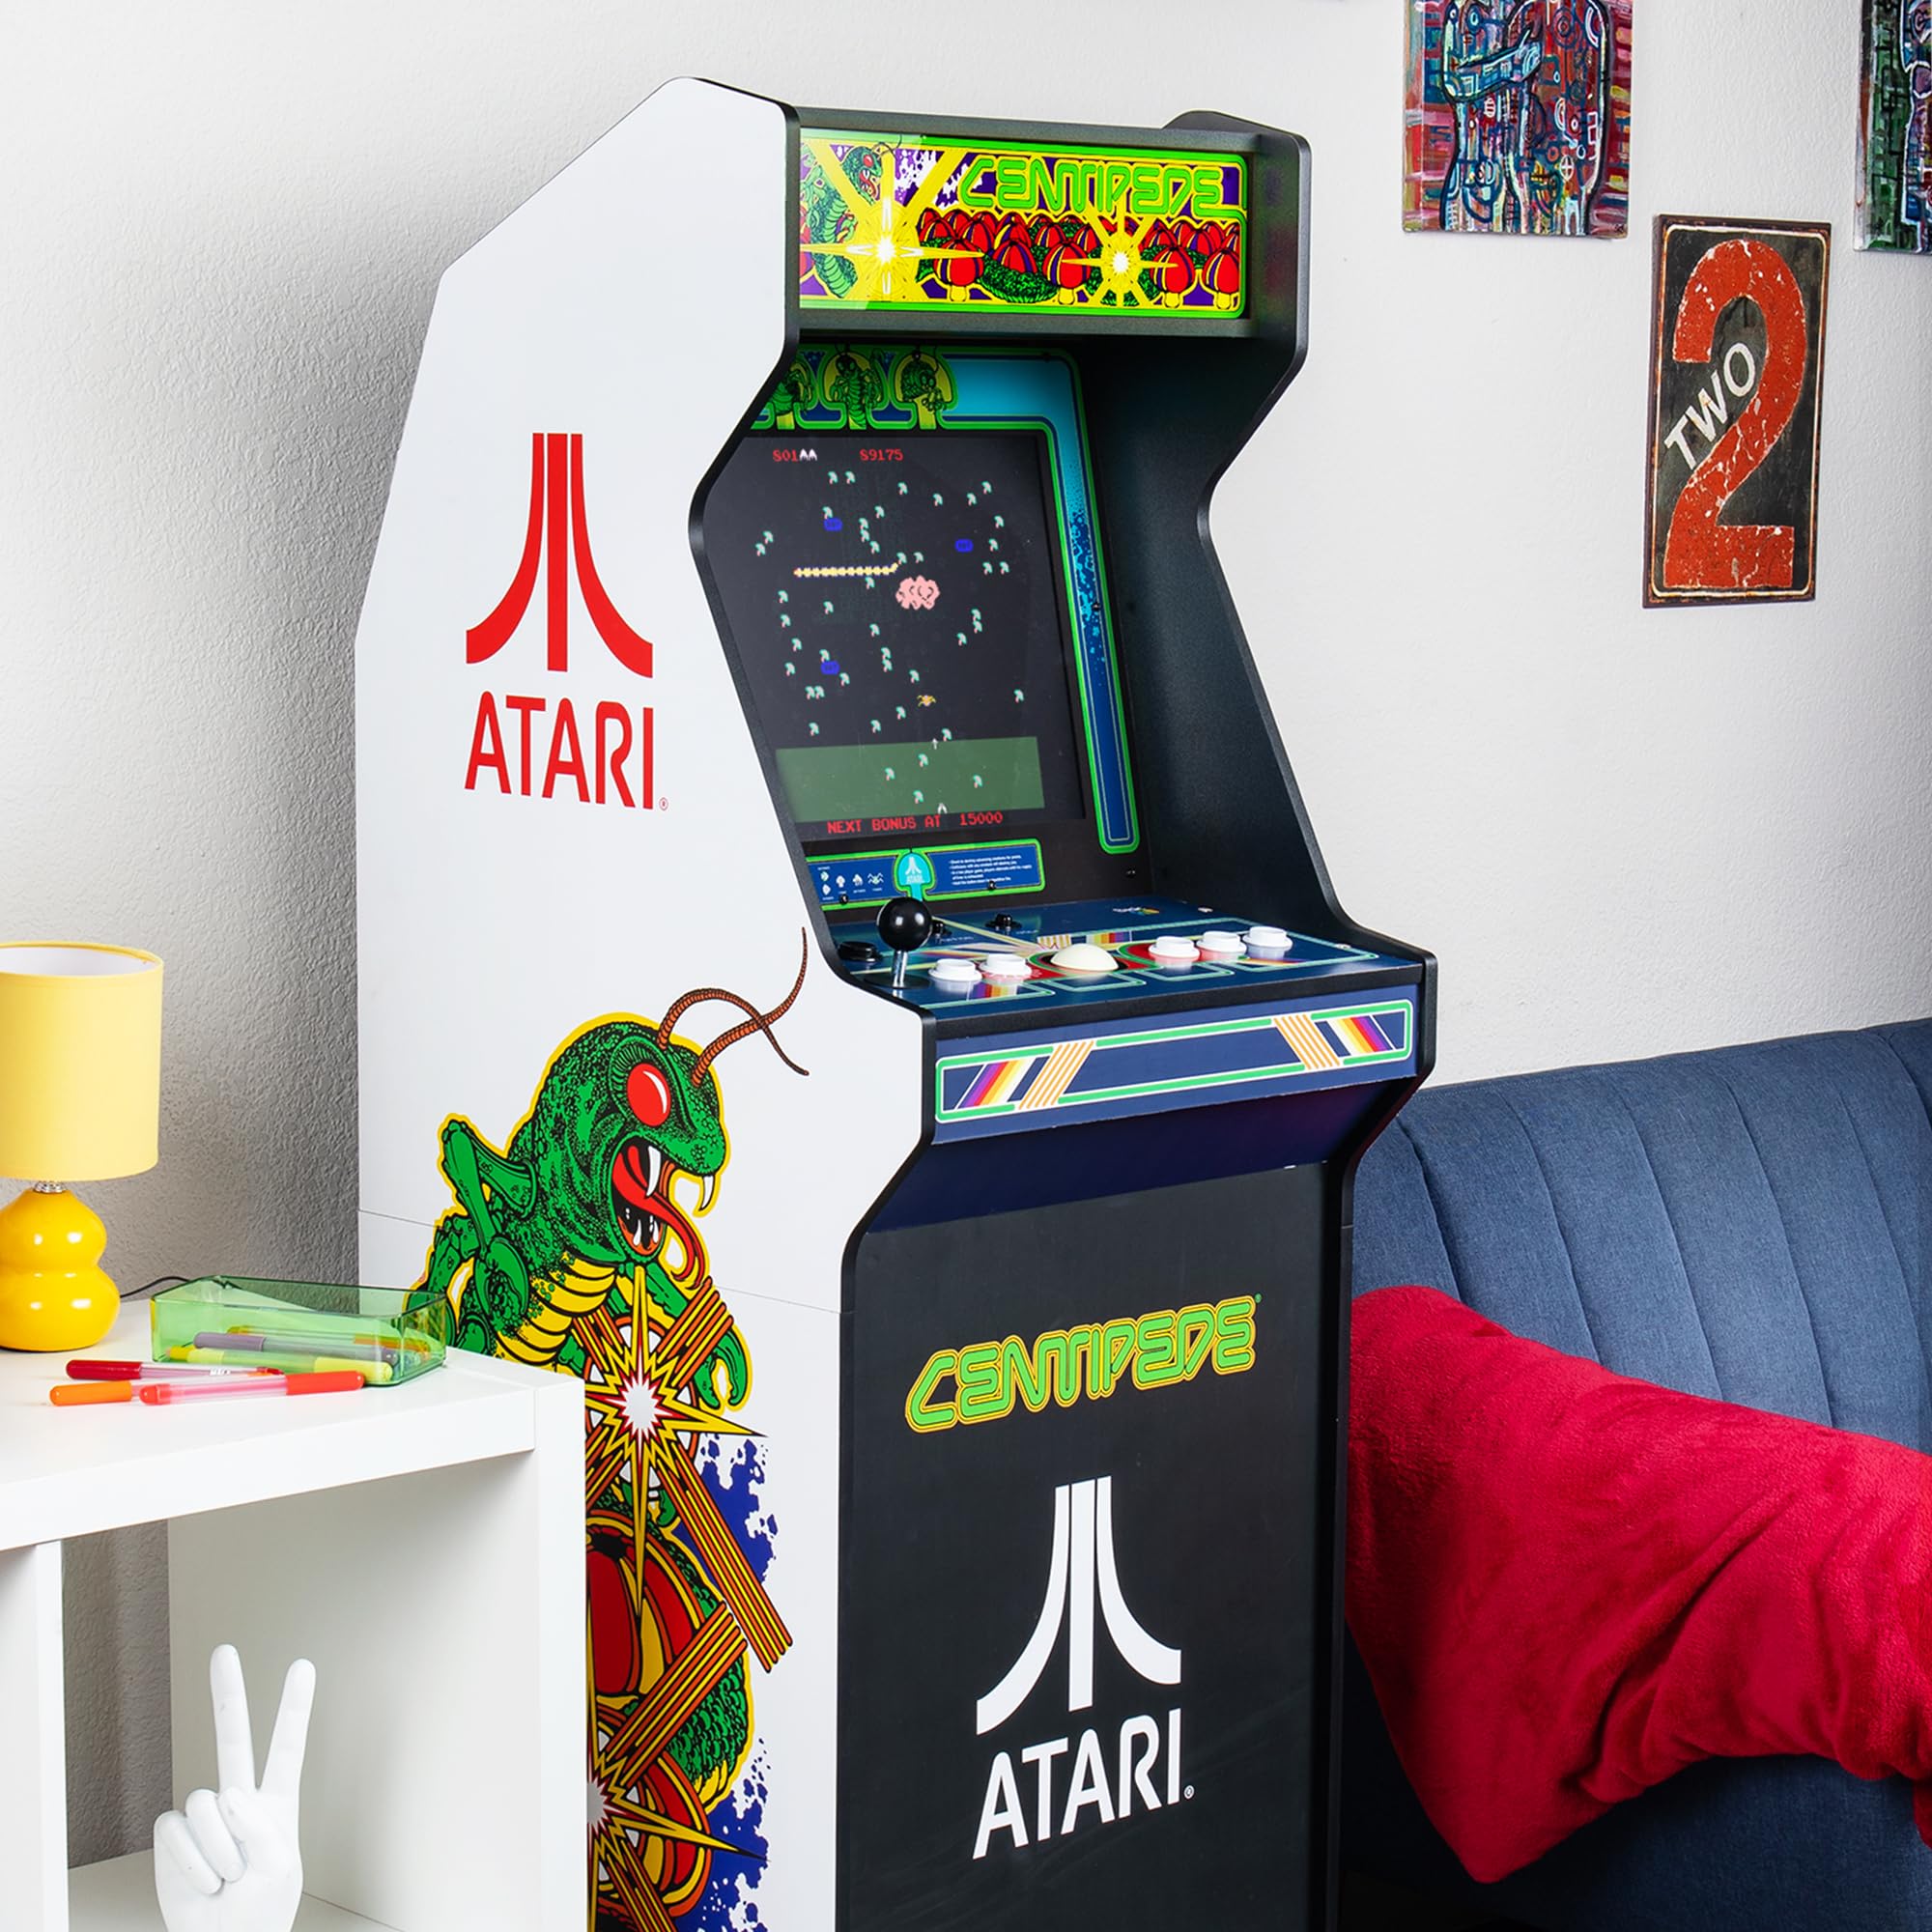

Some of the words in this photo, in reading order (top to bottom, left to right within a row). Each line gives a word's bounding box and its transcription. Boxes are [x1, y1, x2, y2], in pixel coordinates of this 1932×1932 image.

[957, 156, 1226, 218] CENTIPEDE
[1663, 342, 1756, 469] TWO
[1663, 240, 1807, 588] 2
[464, 690, 655, 810] ATARI
[827, 818, 863, 835] NEXT
[871, 814, 917, 833] BONUS
[924, 813, 941, 828] AT
[959, 810, 1004, 826] 15000
[905, 1293, 1255, 1434] CENTIPEDE
[972, 1707, 1181, 1861] ATARI
